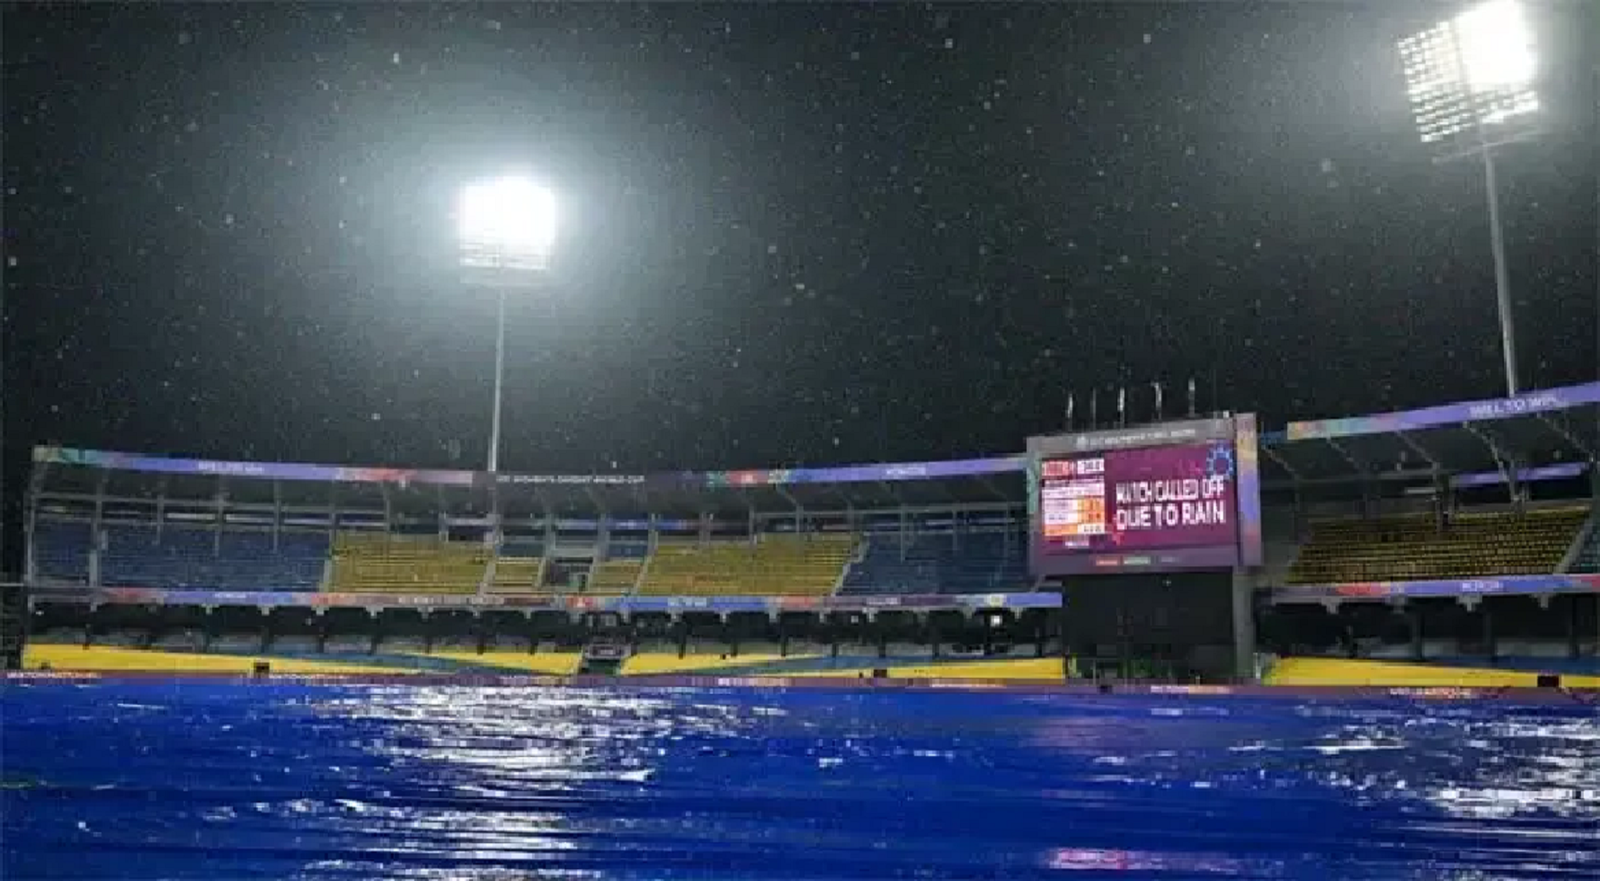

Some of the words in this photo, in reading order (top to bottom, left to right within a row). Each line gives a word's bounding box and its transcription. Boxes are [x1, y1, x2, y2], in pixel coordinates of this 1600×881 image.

[1116, 481, 1152, 504] MATCH
[1156, 479, 1199, 501] CALLED
[1202, 475, 1225, 499] OFF
[1117, 504, 1151, 530] DUE
[1154, 502, 1179, 527] TO
[1182, 500, 1226, 525] RAIN
